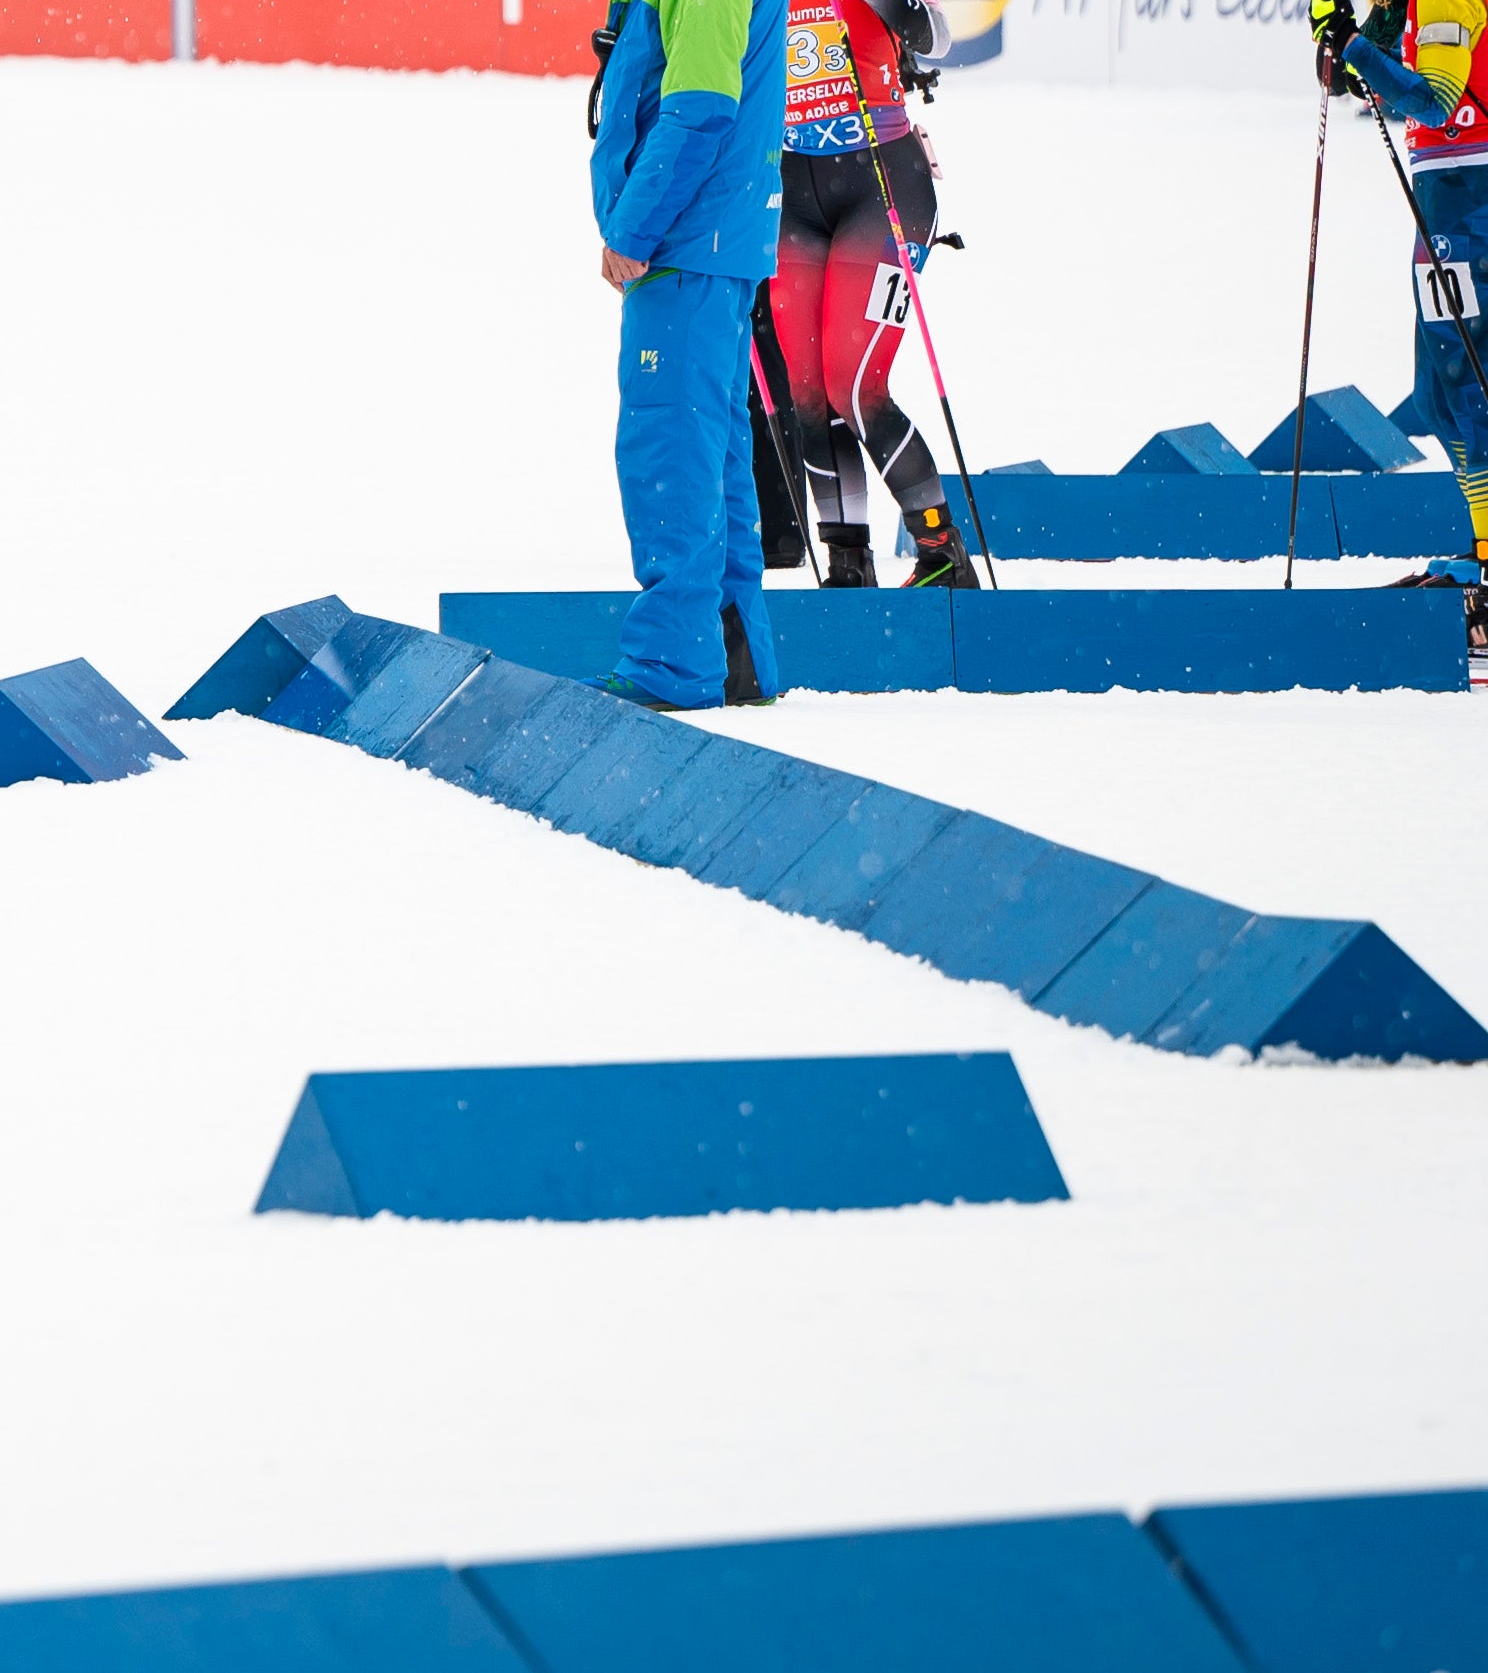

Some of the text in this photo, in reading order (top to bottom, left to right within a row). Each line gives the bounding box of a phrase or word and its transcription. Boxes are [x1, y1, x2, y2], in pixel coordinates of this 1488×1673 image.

[824, 44, 847, 71] 3
[882, 272, 912, 324] 13
[1427, 267, 1465, 318] 10
